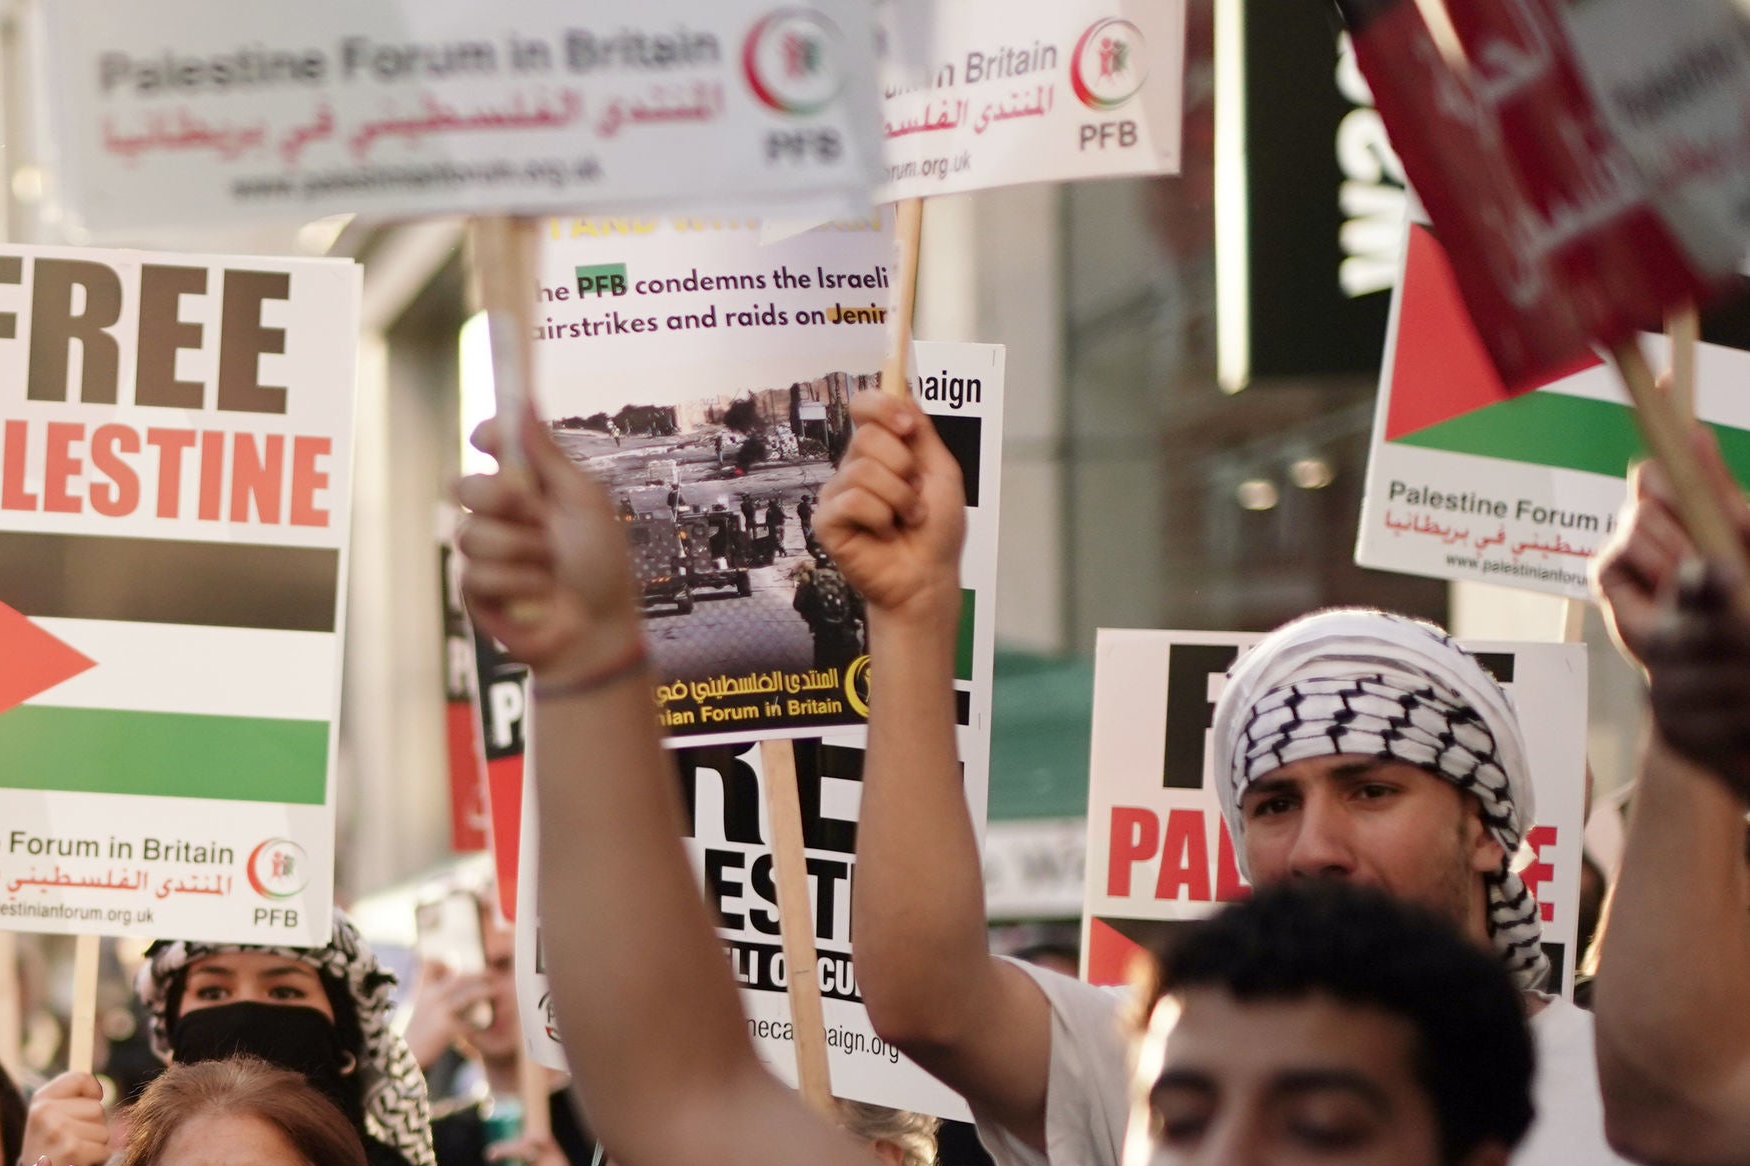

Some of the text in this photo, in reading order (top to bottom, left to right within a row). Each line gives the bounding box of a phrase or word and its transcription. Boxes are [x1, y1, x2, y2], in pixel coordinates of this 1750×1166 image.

[98, 23, 721, 94] Palestine Forum in Britain
[965, 40, 1058, 84] Britain
[974, 84, 1054, 135] المنتدى
[1079, 121, 1138, 150] PFB
[536, 266, 889, 303] he PFB condemns the Israeli
[533, 311, 658, 341] airstrikes
[666, 305, 717, 330] and
[726, 303, 788, 328] raids
[795, 309, 826, 326] on
[1389, 480, 1507, 519] Palestine
[1515, 500, 1598, 532] Forum
[1475, 523, 1505, 559] في
[701, 704, 759, 723] Forum
[765, 701, 782, 717] in
[787, 698, 842, 715] Britain
[9, 830, 99, 857] Forum
[108, 836, 132, 859] in
[143, 838, 234, 865] Britain
[7, 866, 148, 901] الفلسطيني
[155, 871, 232, 900] المنتدى
[253, 908, 299, 929] PFB
